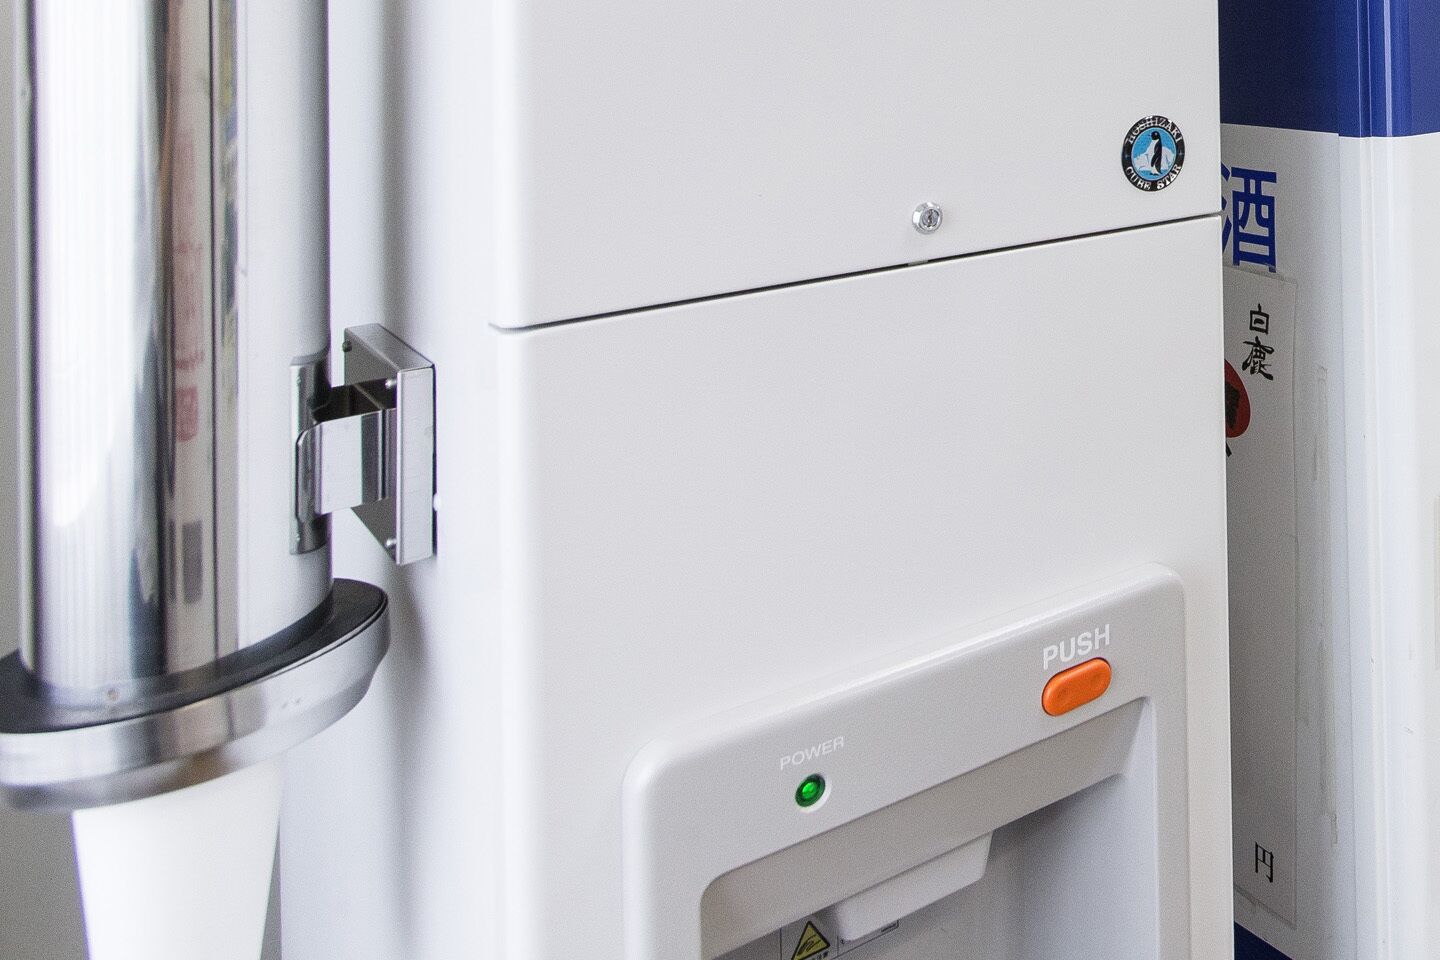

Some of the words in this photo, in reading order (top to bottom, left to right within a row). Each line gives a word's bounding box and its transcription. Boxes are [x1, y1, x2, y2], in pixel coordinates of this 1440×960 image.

[1221, 163, 1277, 273] 酒
[1043, 623, 1111, 670] PUSH
[779, 736, 845, 771] POWER
[1254, 842, 1275, 884] 円
